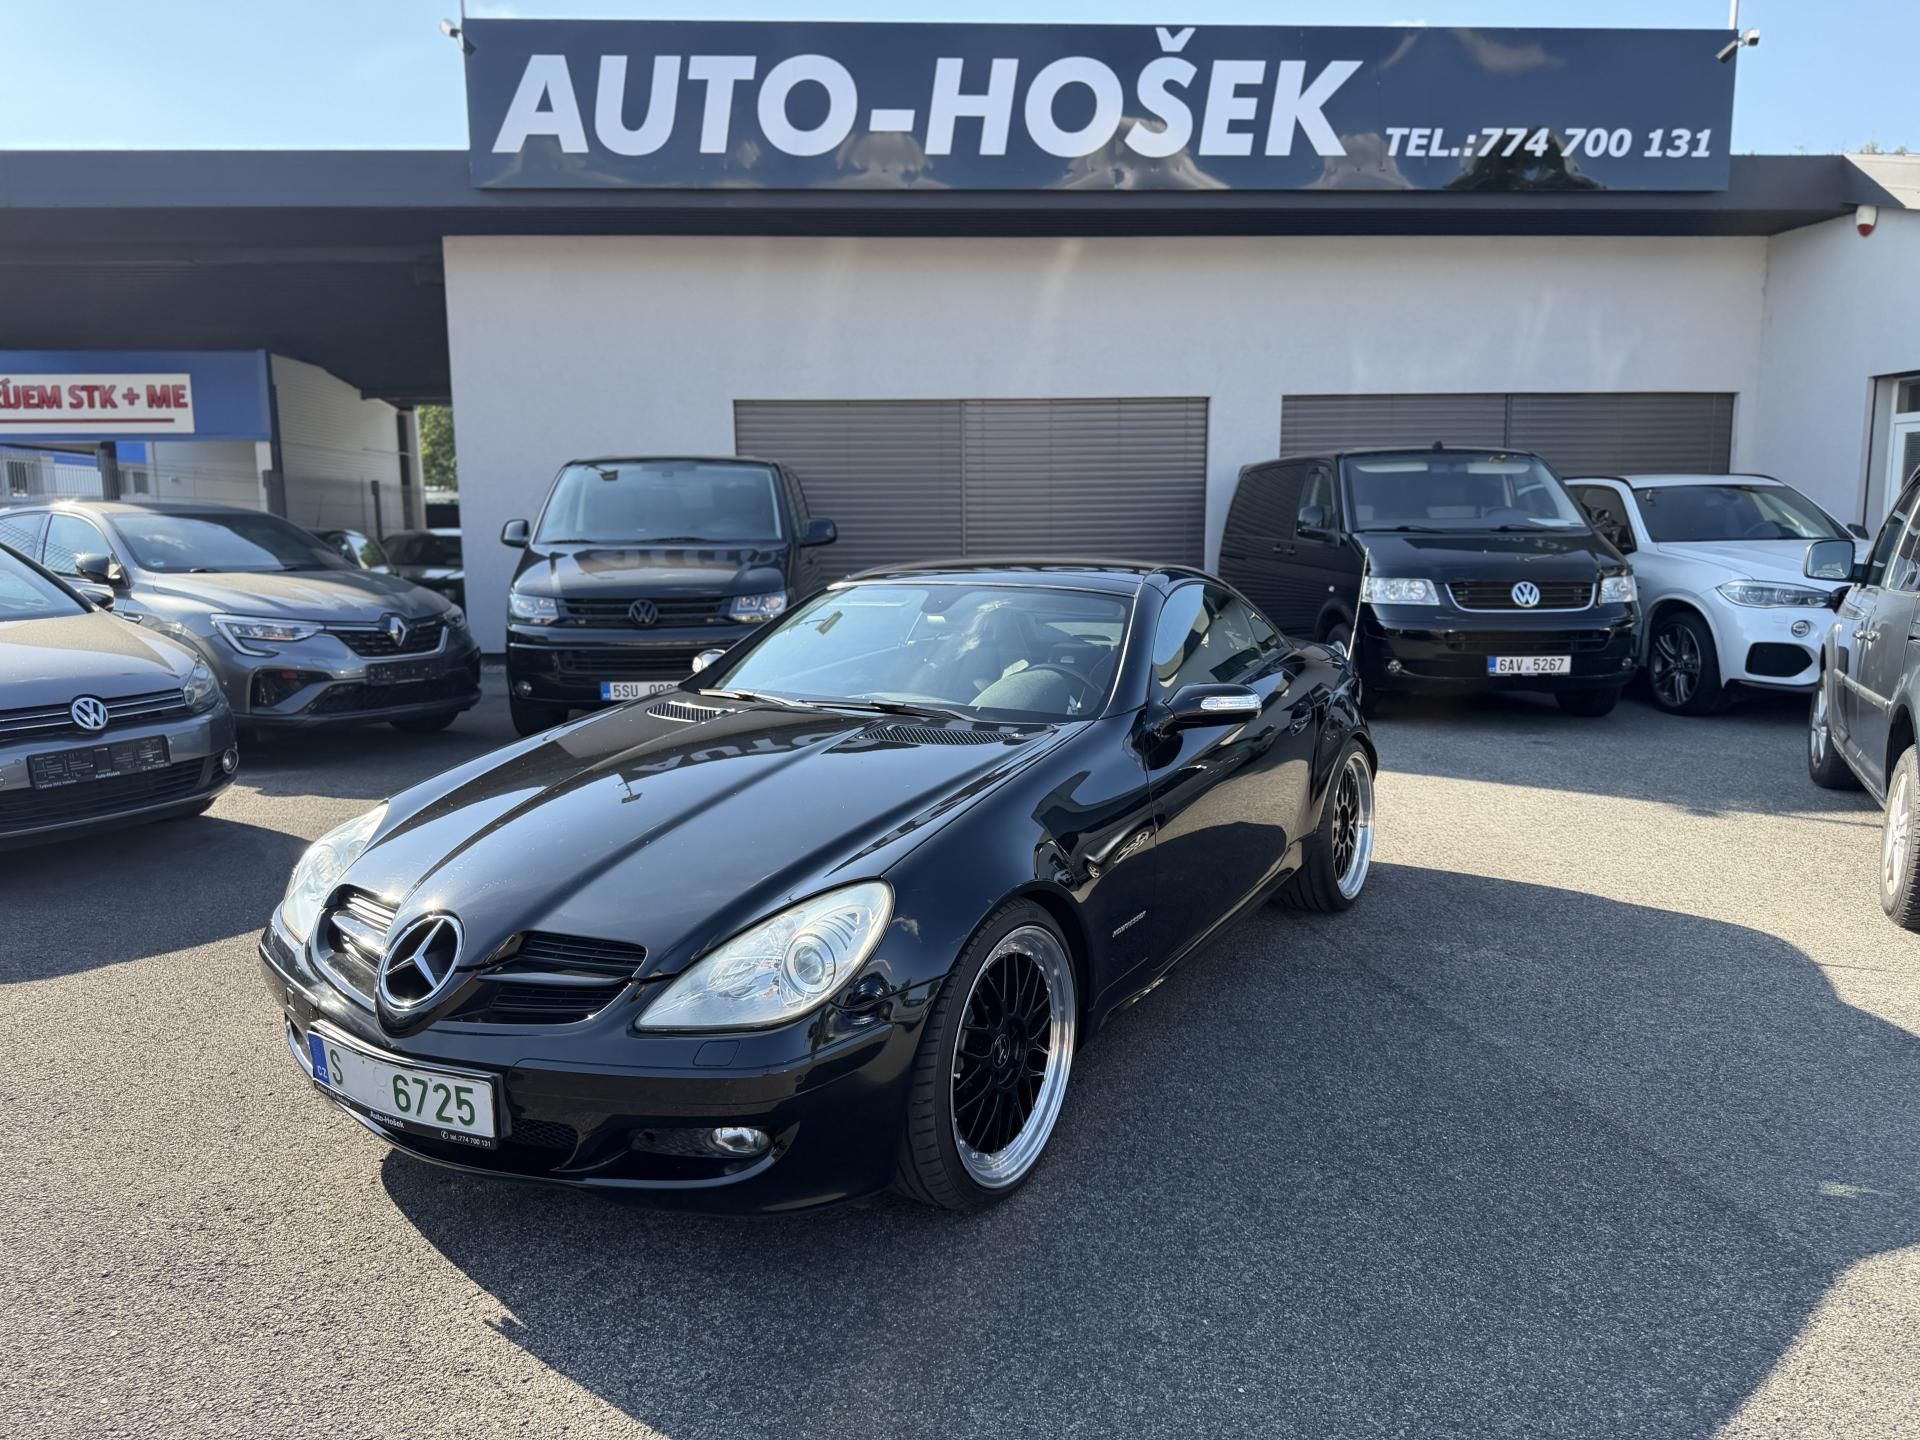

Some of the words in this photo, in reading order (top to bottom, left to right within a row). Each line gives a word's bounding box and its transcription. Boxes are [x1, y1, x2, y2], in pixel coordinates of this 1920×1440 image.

[491, 27, 1364, 159] AUTO-HOŠEK
[1385, 127, 1549, 158] TEL.:774
[1560, 127, 1633, 158] 700
[1643, 127, 1712, 158] 131
[68, 384, 118, 409] STK
[146, 384, 188, 409] ME
[1500, 659, 1523, 672] 6AV
[1533, 658, 1565, 672] 5267
[613, 684, 639, 698] 5SU
[330, 1049, 343, 1085] S
[393, 1074, 475, 1126] 6725
